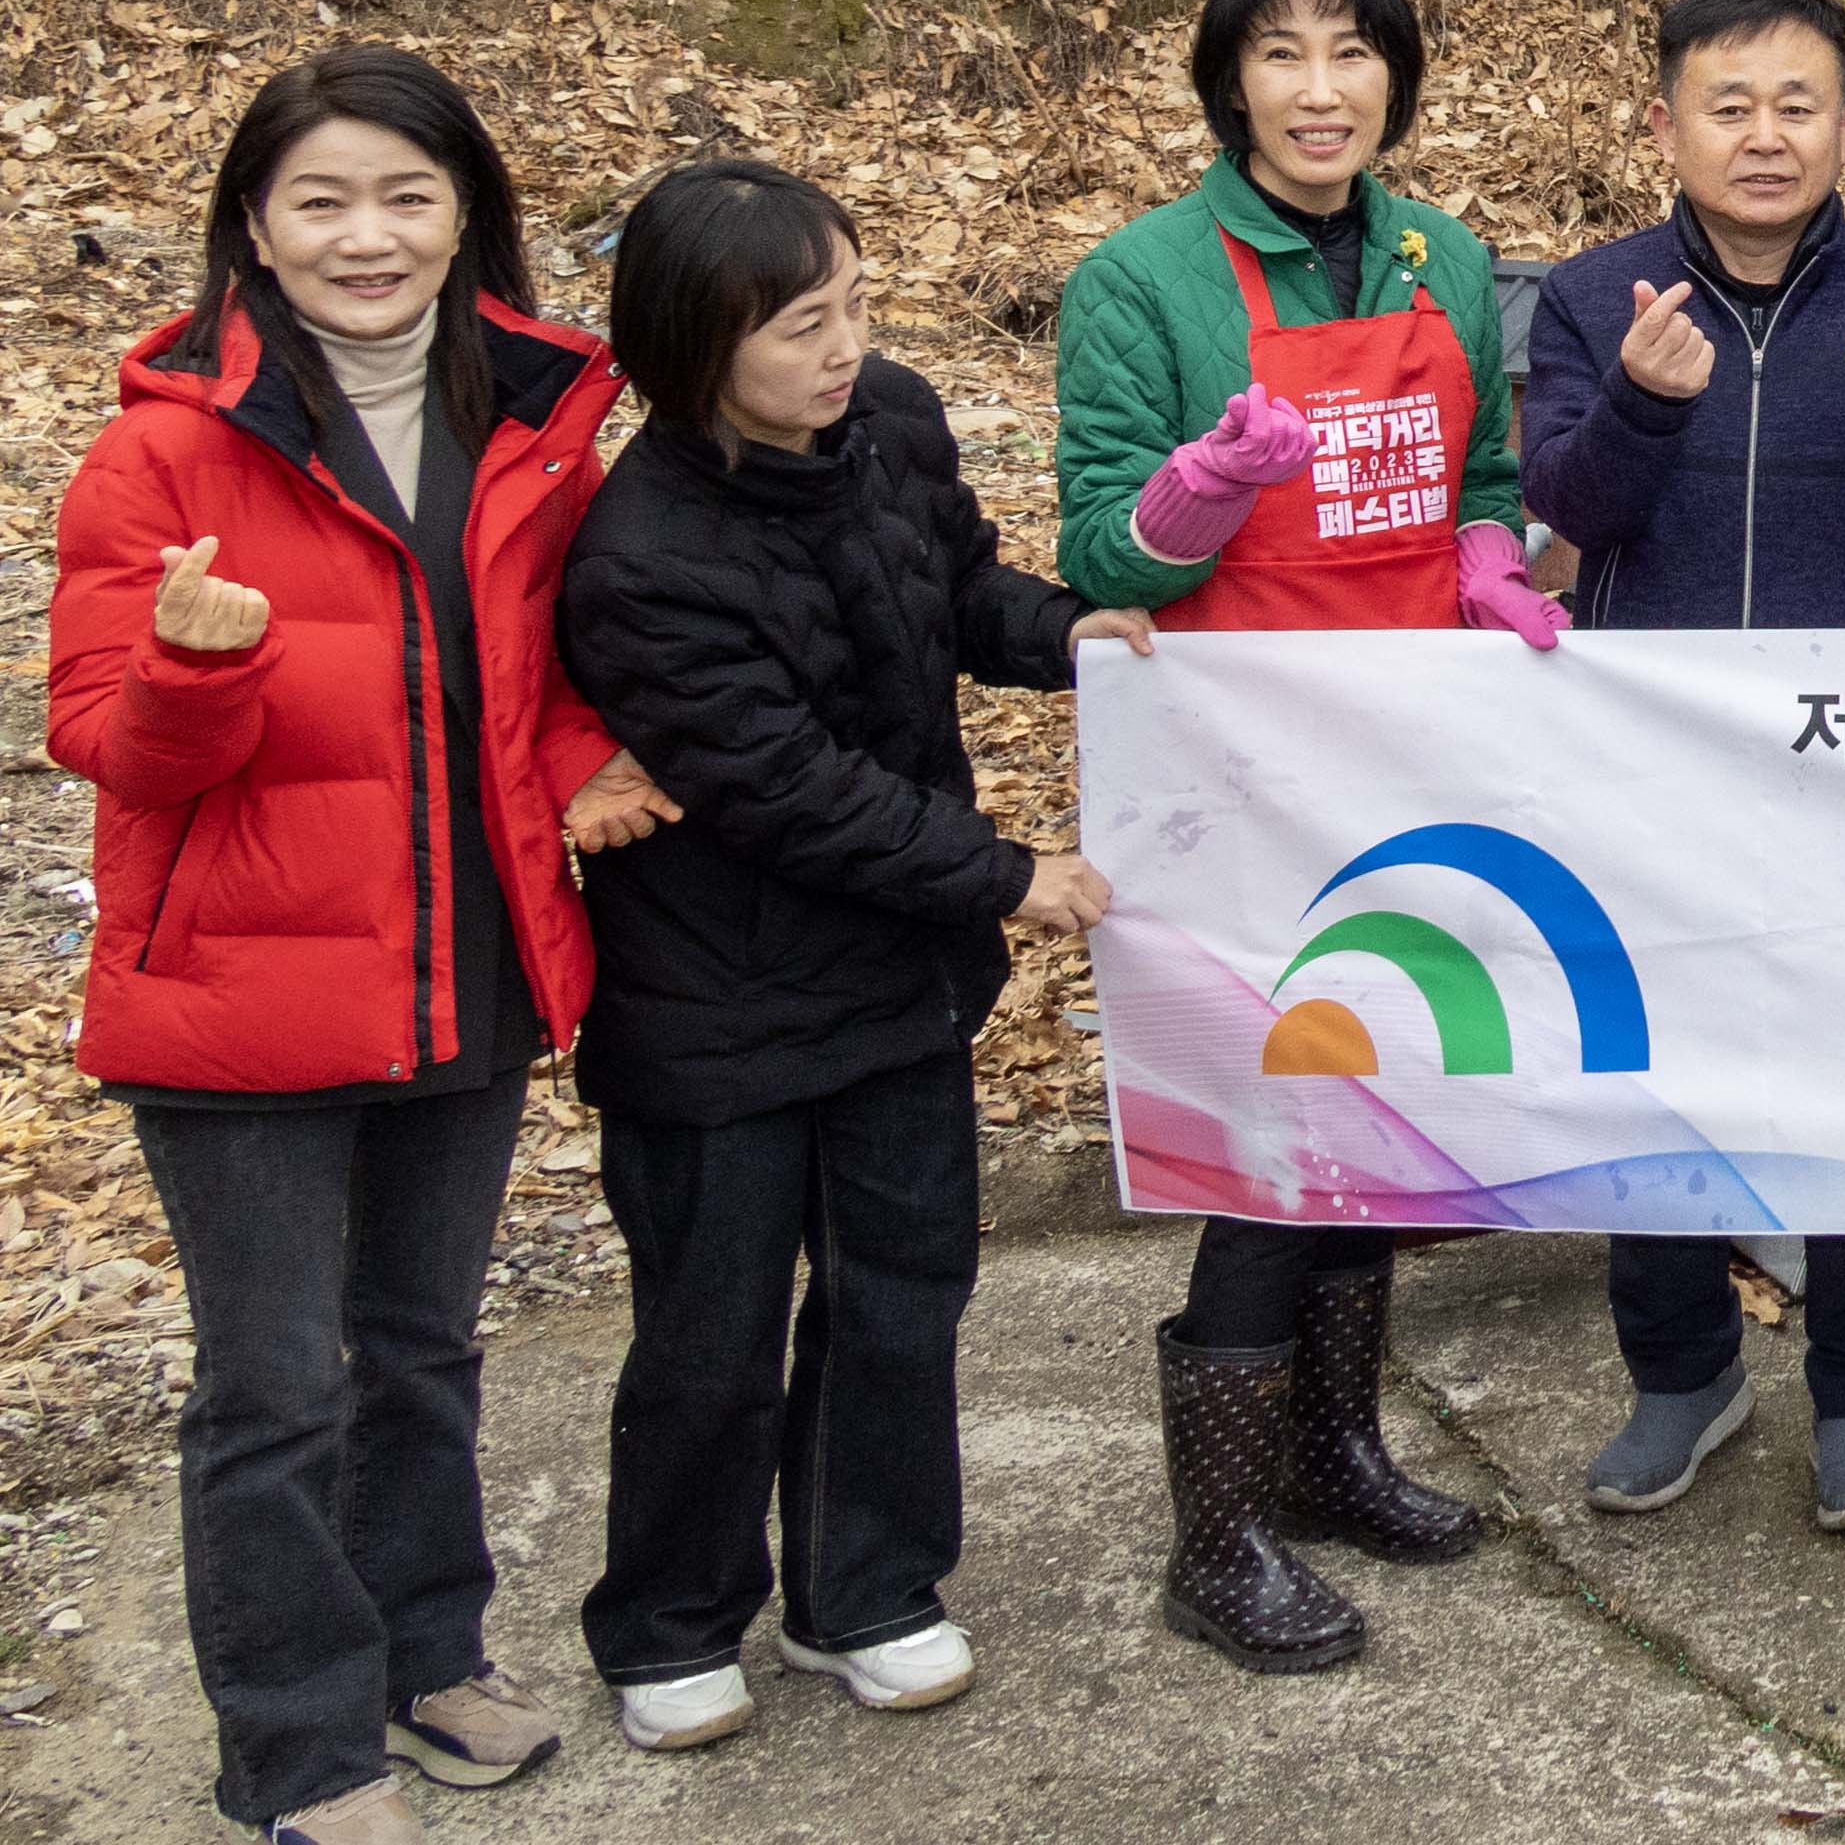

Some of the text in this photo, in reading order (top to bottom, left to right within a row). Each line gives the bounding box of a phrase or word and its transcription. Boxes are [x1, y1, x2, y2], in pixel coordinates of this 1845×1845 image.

[1308, 405, 1443, 456] 대덕거리
[1351, 450, 1414, 473] 2023
[1316, 484, 1448, 539] 페스티벌
